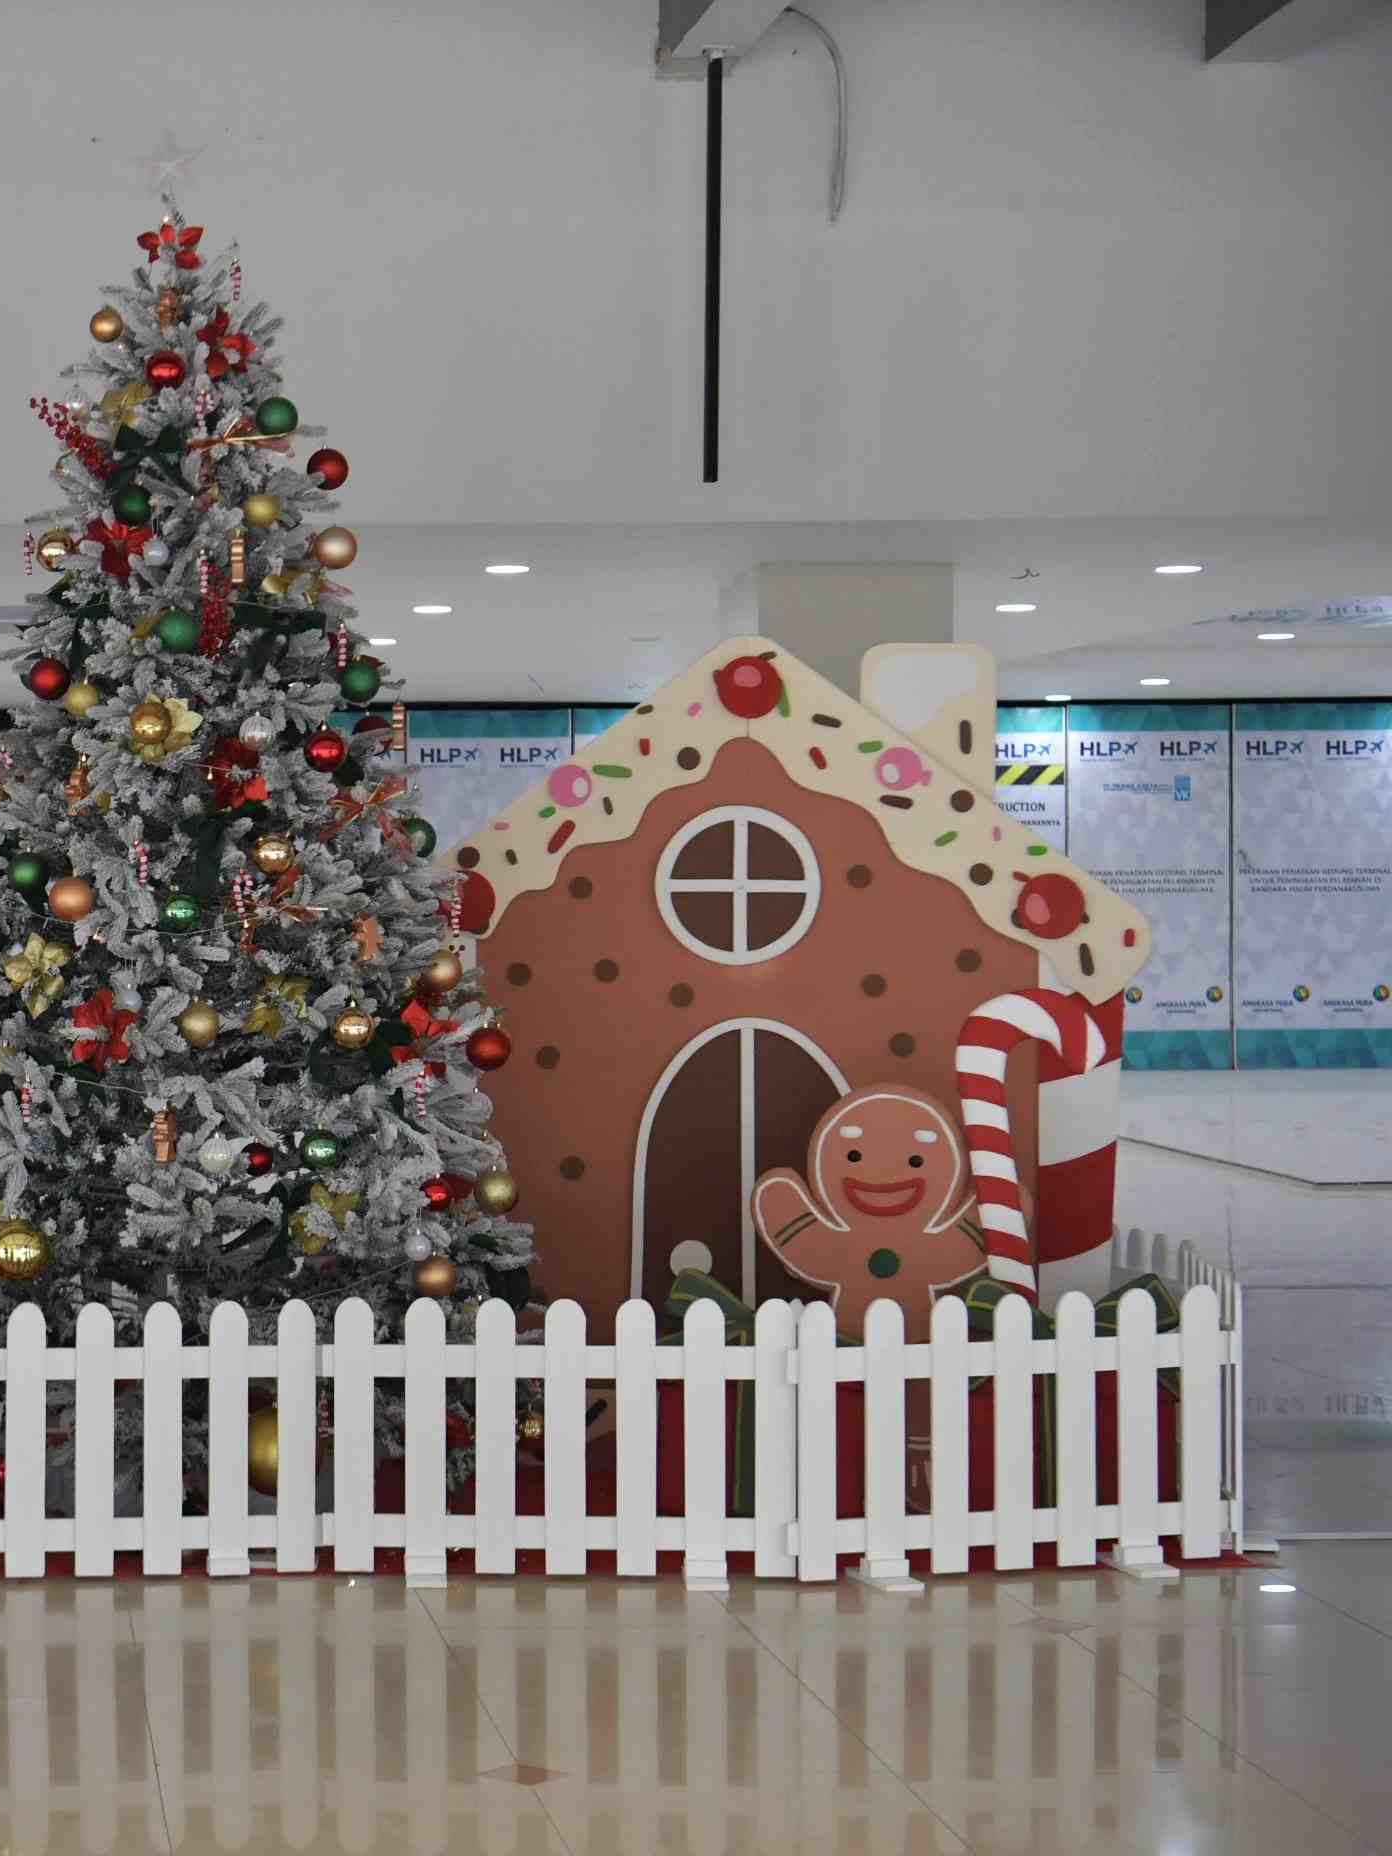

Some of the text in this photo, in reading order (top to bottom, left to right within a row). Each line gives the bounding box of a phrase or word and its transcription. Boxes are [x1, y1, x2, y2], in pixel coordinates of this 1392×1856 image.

[420, 747, 461, 763] HLP
[500, 747, 541, 763] HLP
[995, 743, 1035, 758] HLP
[1080, 740, 1122, 757] HLP
[1160, 740, 1201, 756] HLP
[1246, 740, 1287, 756] HLP
[1326, 740, 1368, 756] HLP
